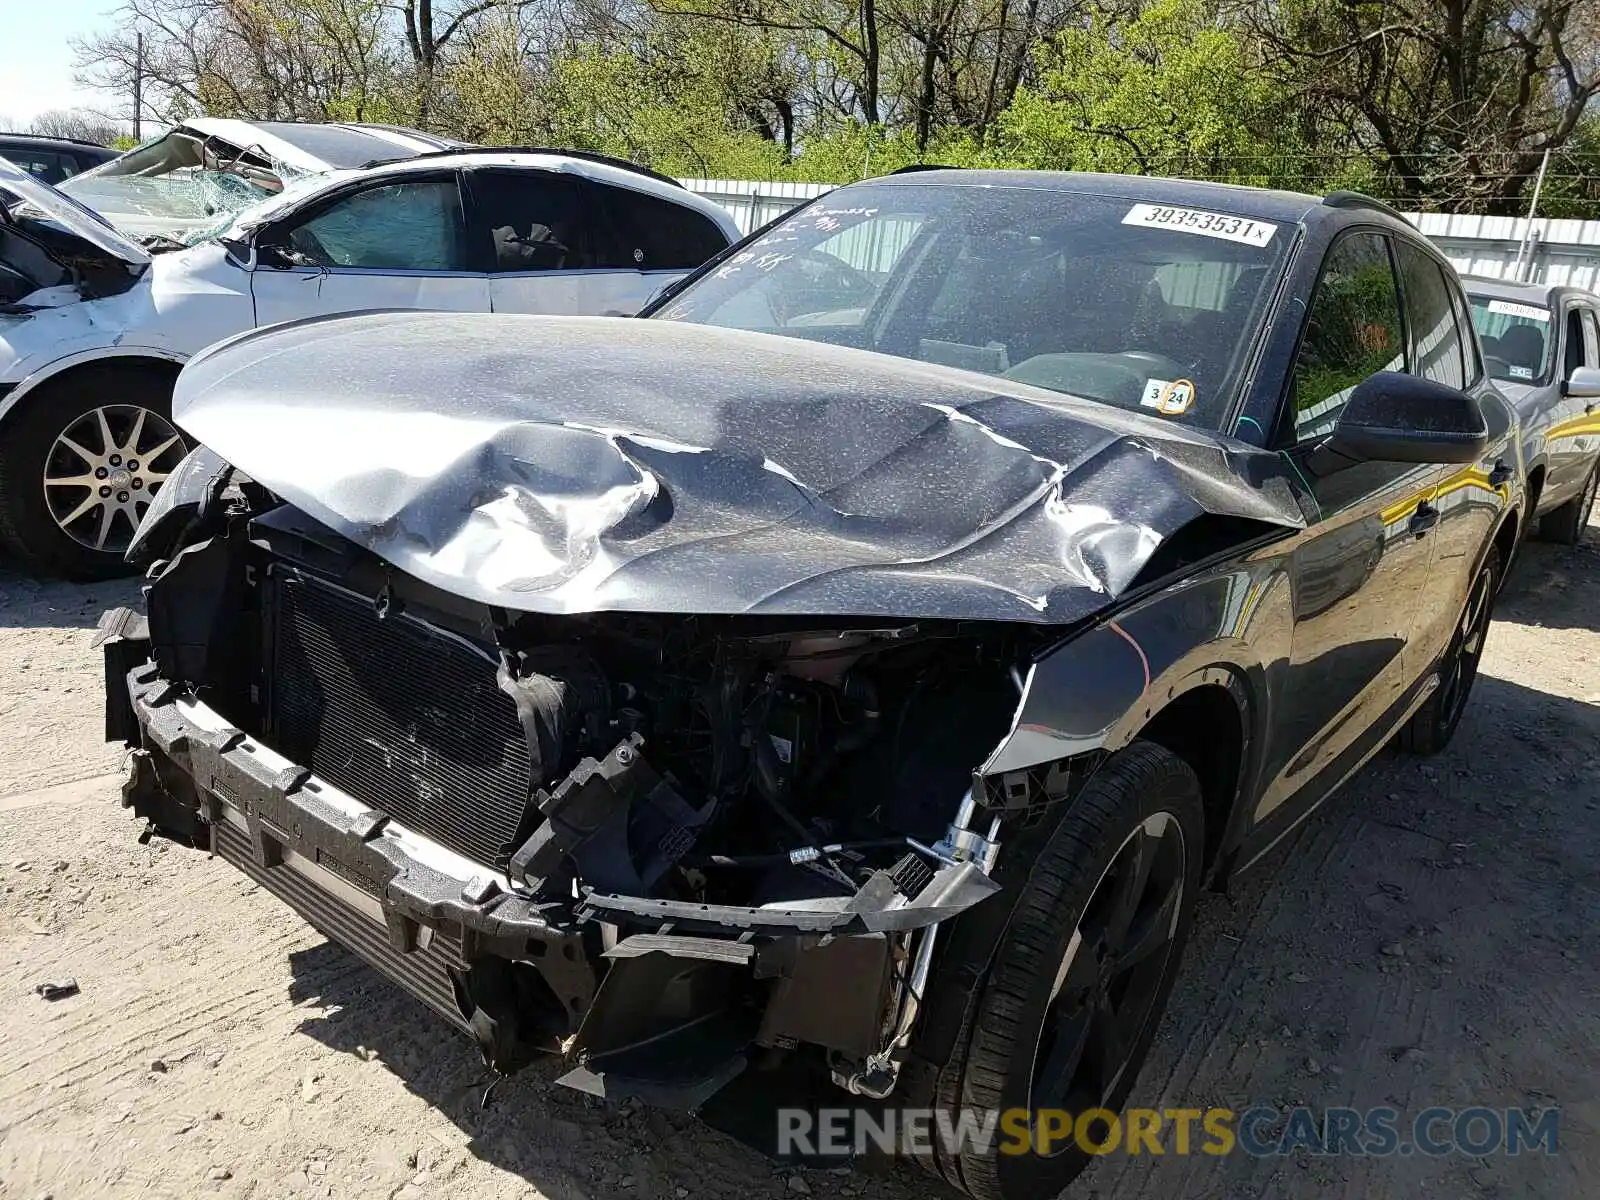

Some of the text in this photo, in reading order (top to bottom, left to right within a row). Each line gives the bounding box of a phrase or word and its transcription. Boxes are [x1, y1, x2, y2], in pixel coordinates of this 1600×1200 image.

[1144, 207, 1255, 237] 39353531
[1151, 388, 1184, 404] 3 24
